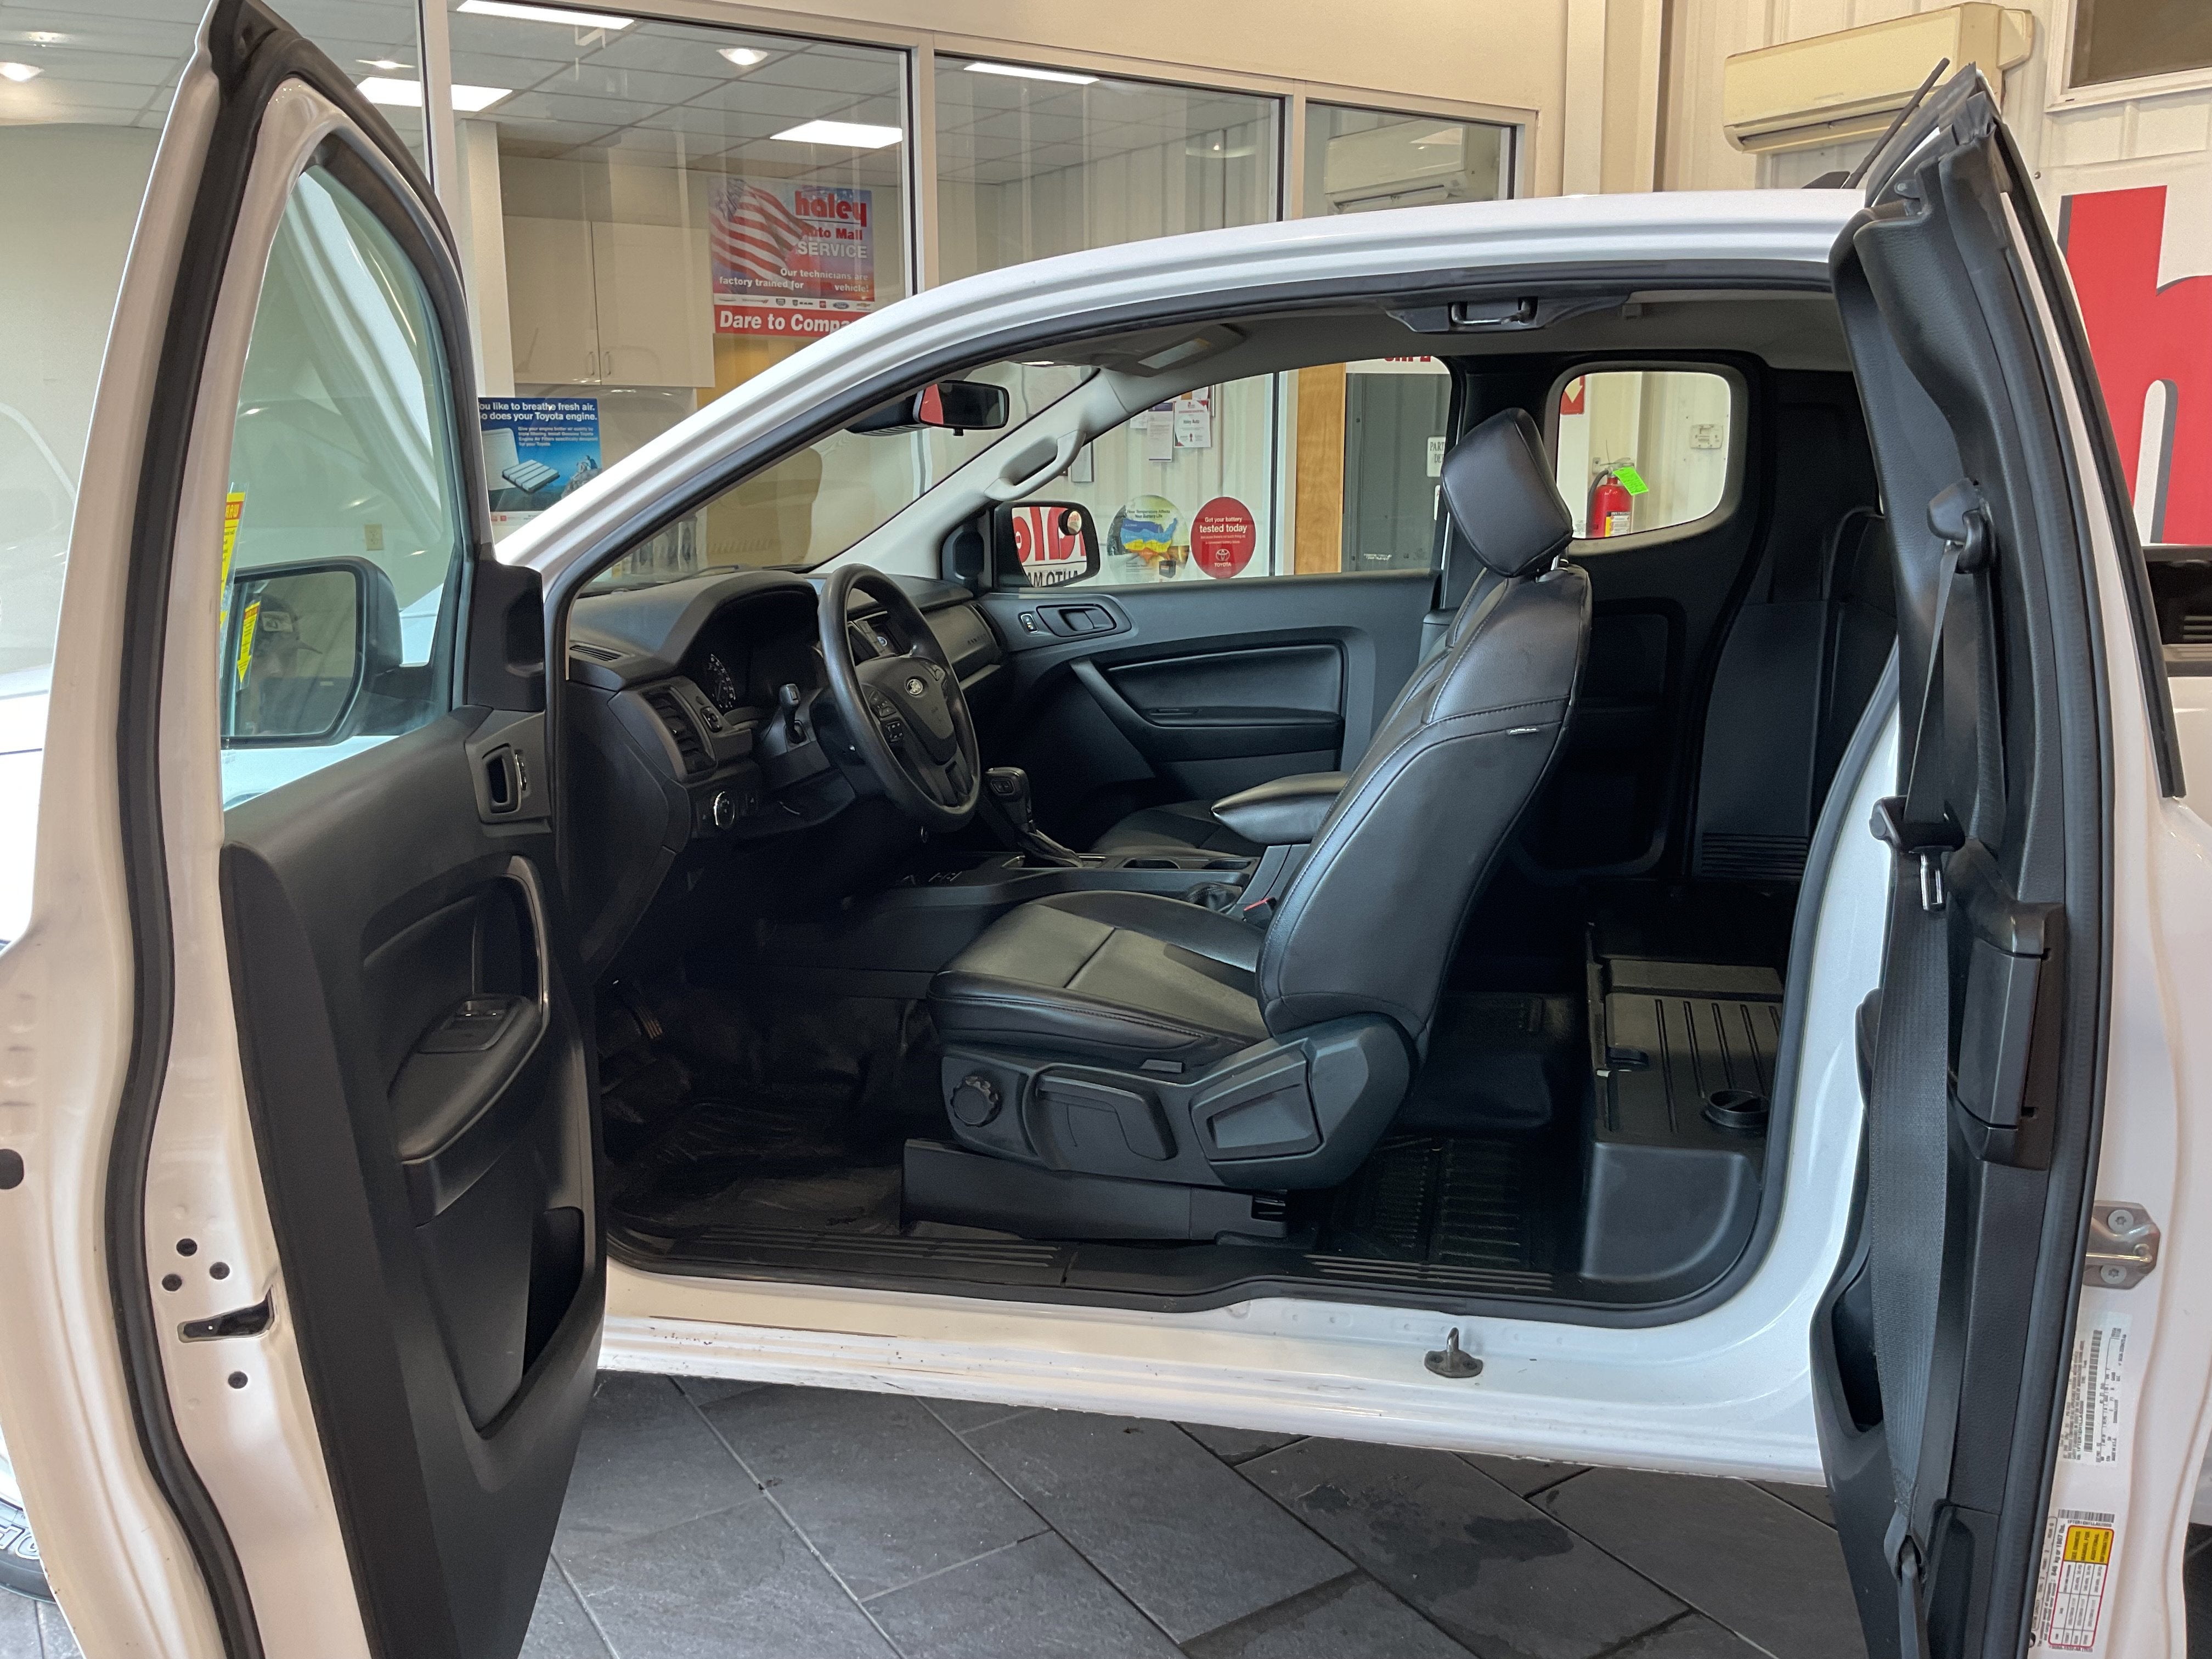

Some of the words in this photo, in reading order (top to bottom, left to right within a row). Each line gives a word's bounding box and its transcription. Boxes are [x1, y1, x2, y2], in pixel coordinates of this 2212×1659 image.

[795, 191, 867, 227] haley
[804, 227, 831, 238] uto
[836, 228, 862, 240] Mall
[798, 241, 867, 258] SERVICE
[800, 269, 851, 280] technicians
[720, 276, 752, 287] factory
[755, 280, 788, 288] trained
[791, 280, 804, 290] for
[834, 284, 869, 292] vehicle!
[720, 311, 762, 329] Dare
[768, 313, 785, 330] to
[493, 402, 509, 410] like
[511, 402, 520, 410] to
[522, 402, 556, 410] breathe
[558, 402, 579, 410] fresh
[582, 402, 595, 410] air.
[514, 413, 533, 421] your
[535, 412, 563, 421] Toyota
[566, 412, 597, 422] engine.
[1200, 524, 1224, 533] tested
[1226, 523, 1248, 534] today
